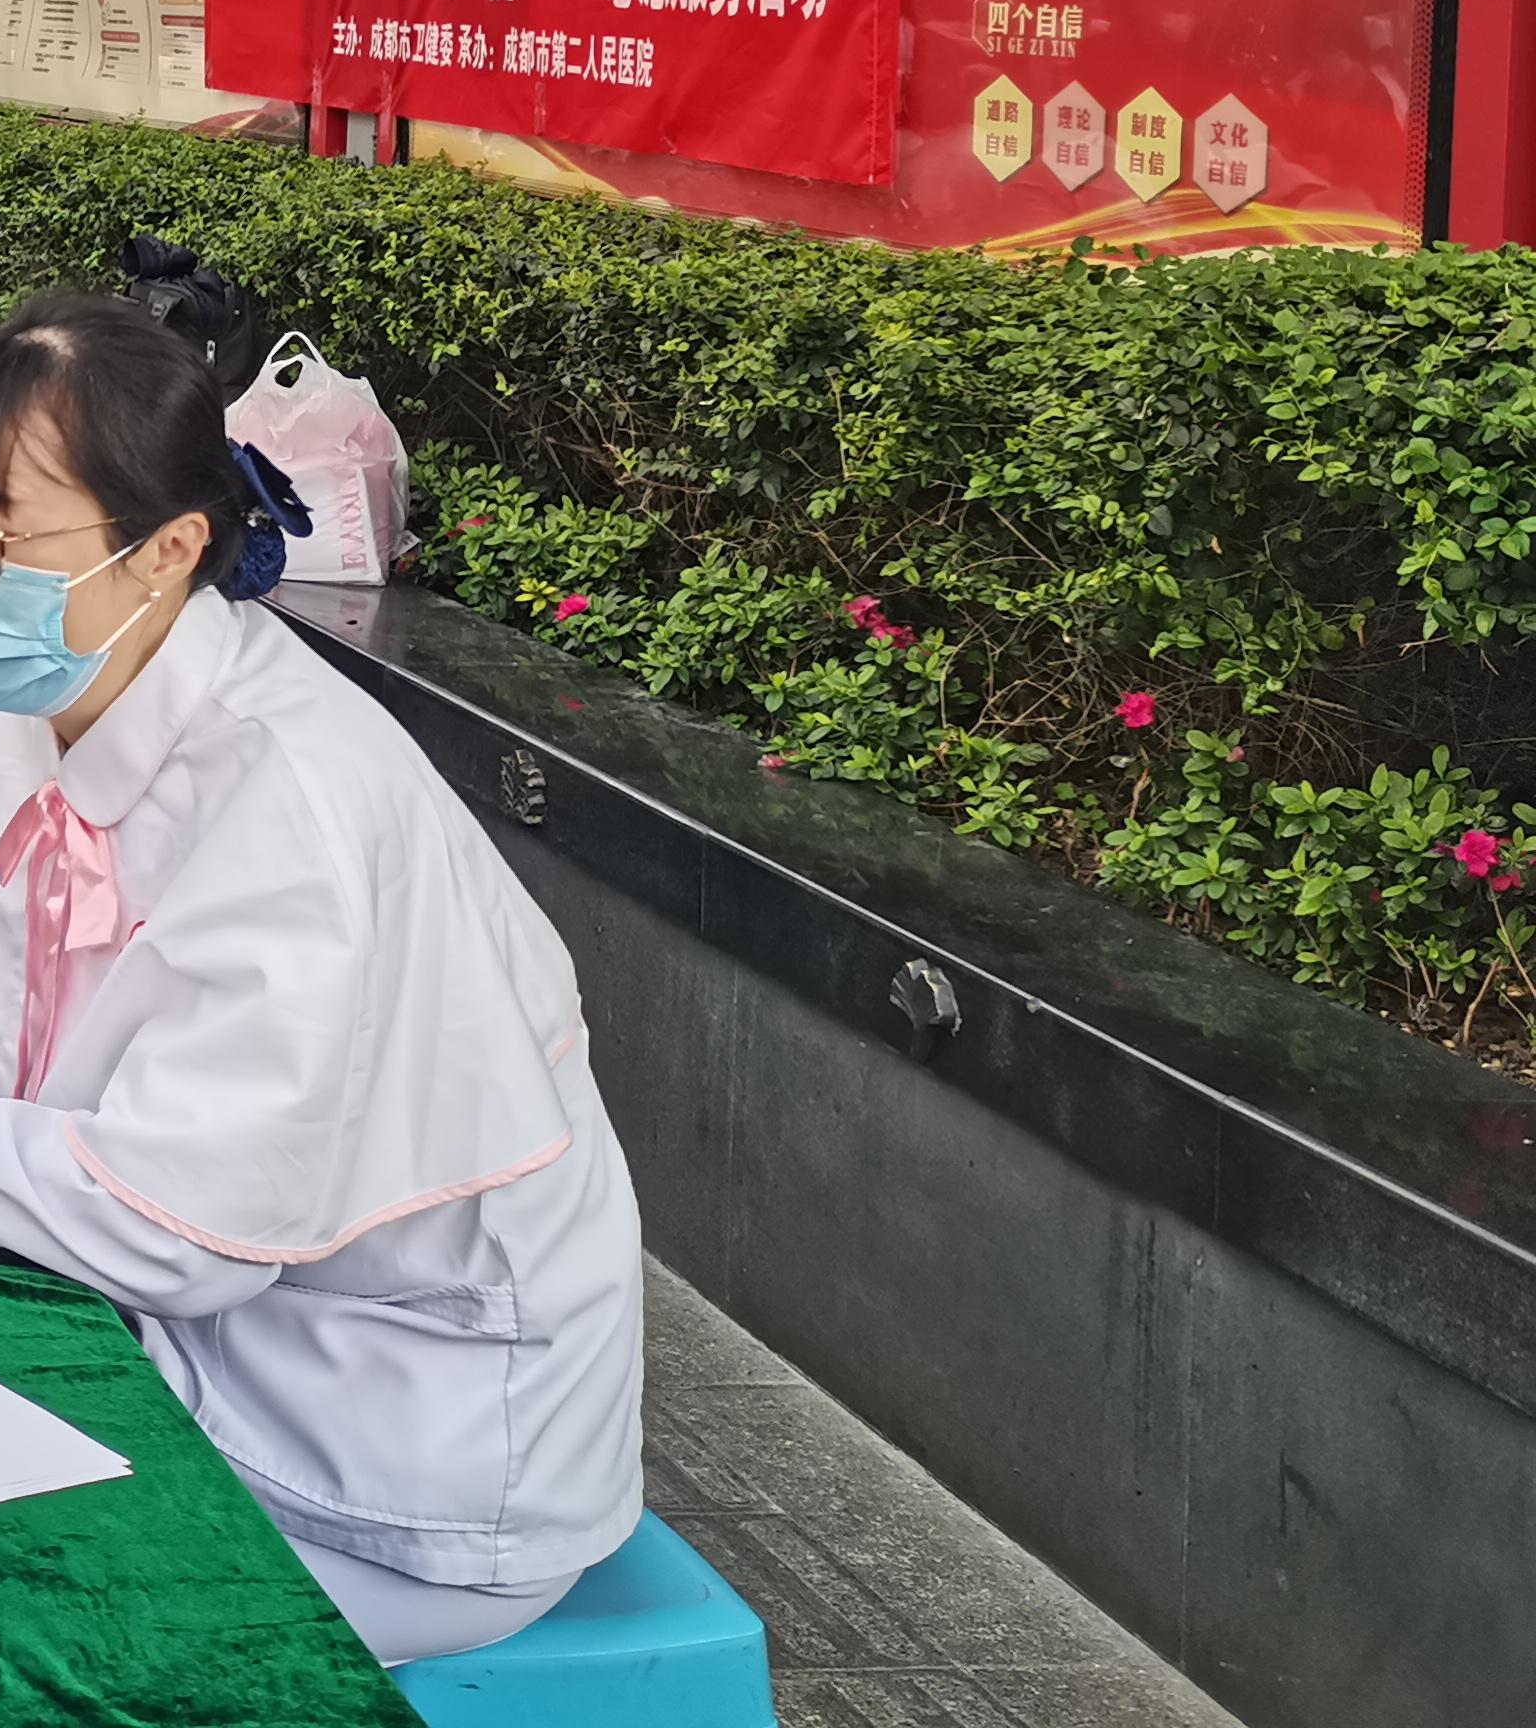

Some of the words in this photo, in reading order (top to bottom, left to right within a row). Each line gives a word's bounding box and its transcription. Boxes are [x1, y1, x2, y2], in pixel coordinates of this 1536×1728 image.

[987, 0, 1084, 41] 四个自信
[987, 36, 1005, 55] SI
[1008, 37, 1026, 56] GE
[1029, 37, 1046, 57] ZI
[1051, 38, 1077, 59] XIN
[985, 98, 1020, 124] 道路
[1056, 105, 1092, 131] 理论
[1130, 112, 1167, 140] 制度
[1209, 119, 1249, 149] 文化
[984, 133, 1019, 158] 自信
[1055, 140, 1090, 167] 自信
[1129, 149, 1166, 177] 自信
[1207, 159, 1248, 188] 自信
